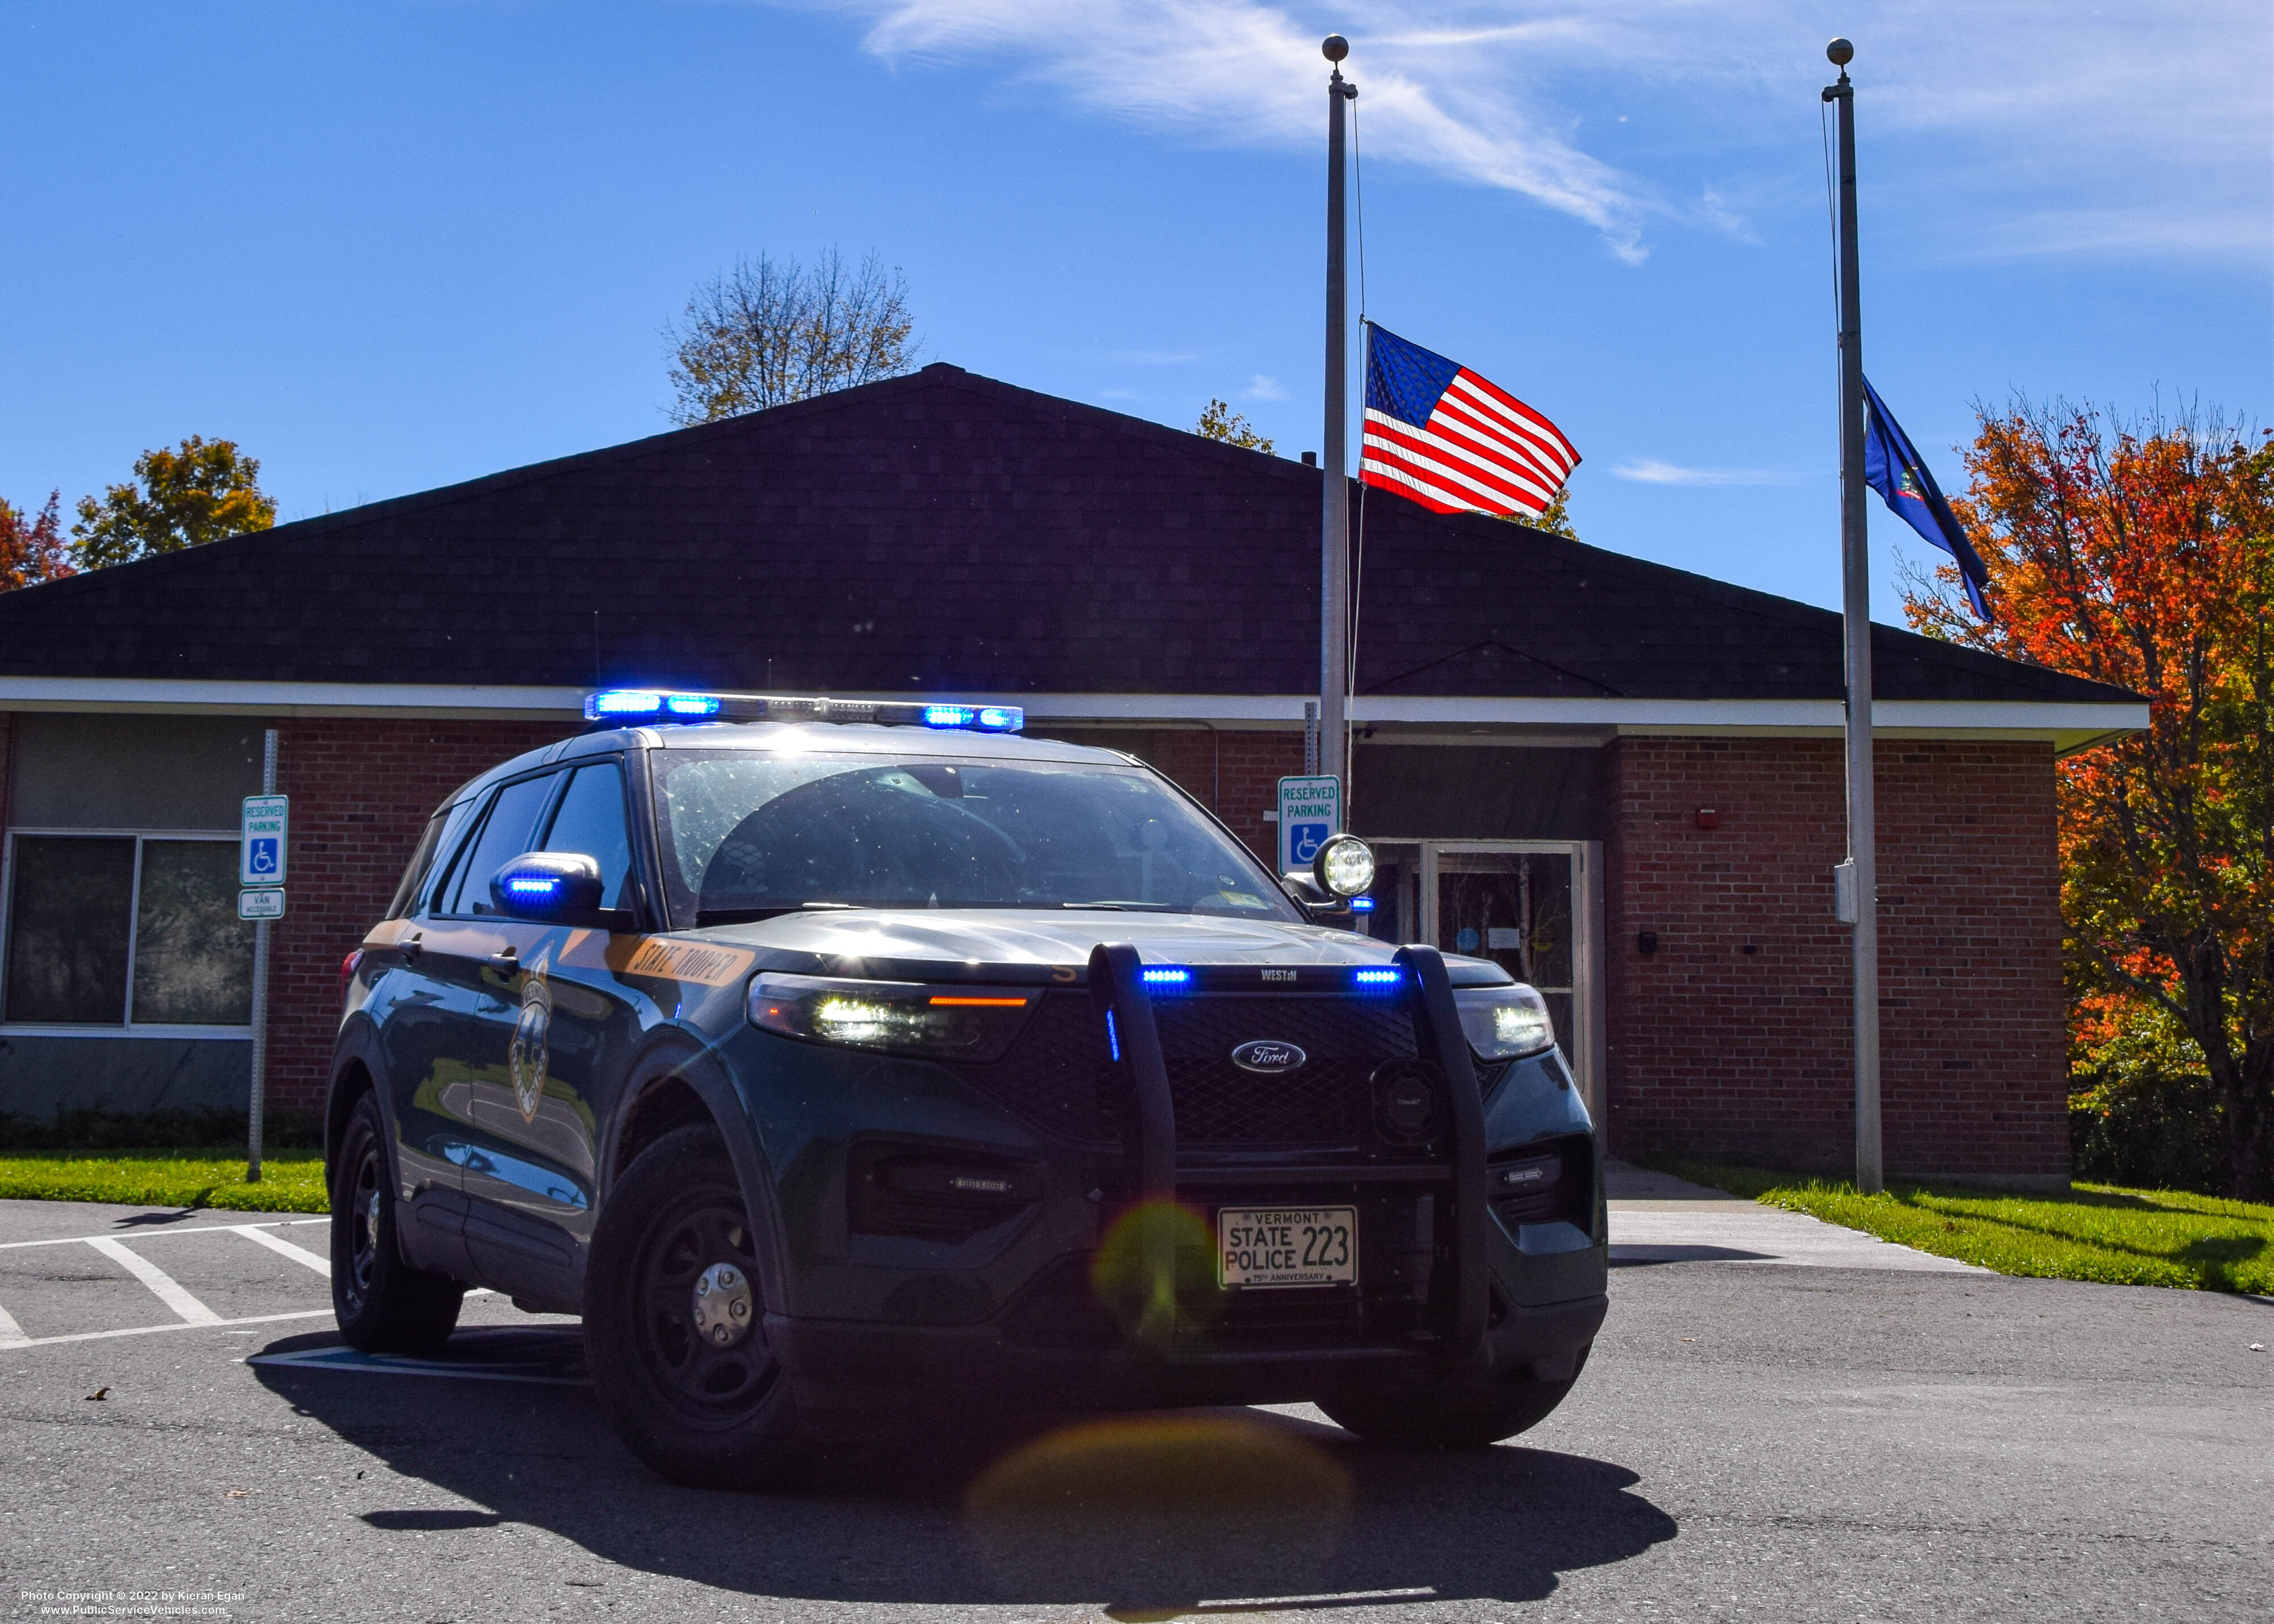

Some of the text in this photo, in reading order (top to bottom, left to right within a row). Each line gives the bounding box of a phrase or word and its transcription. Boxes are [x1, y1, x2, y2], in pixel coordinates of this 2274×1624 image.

[1283, 787, 1335, 800] RESERVED
[245, 805, 284, 817] RESERVED
[1287, 804, 1331, 817] PARKING
[248, 821, 281, 832] PARKING
[254, 896, 270, 904] VAN
[633, 944, 737, 981] STATE TROOPER
[1251, 1046, 1289, 1064] Ford
[1255, 1212, 1319, 1224] VERMONT
[1230, 1227, 1292, 1247] STATE
[1302, 1226, 1348, 1266] 223
[1225, 1250, 1296, 1270] POLICE
[1271, 1273, 1324, 1281] ANNIVERSARY
